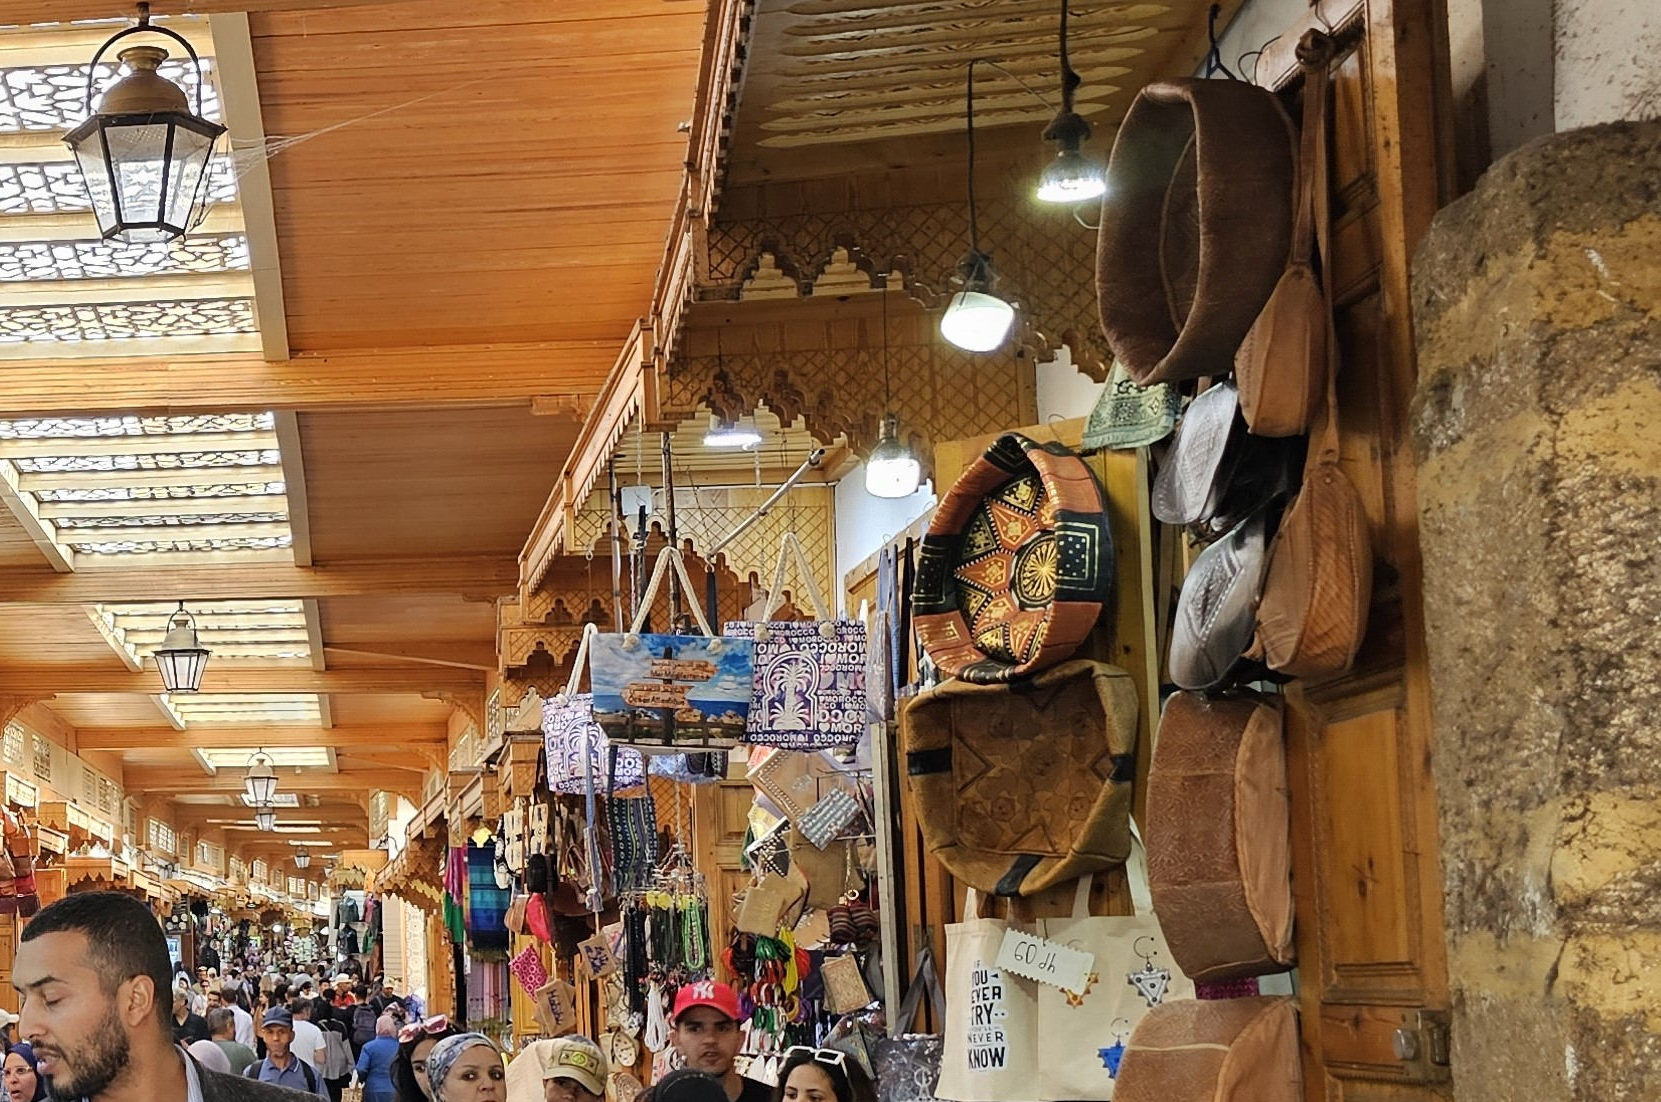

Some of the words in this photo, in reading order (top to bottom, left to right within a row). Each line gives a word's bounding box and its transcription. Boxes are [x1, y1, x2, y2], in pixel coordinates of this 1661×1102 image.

[1013, 940, 1038, 965] 60
[1038, 952, 1057, 974] dh
[968, 1031, 1004, 1044] NEVER
[968, 1046, 1006, 1070] KNOW
